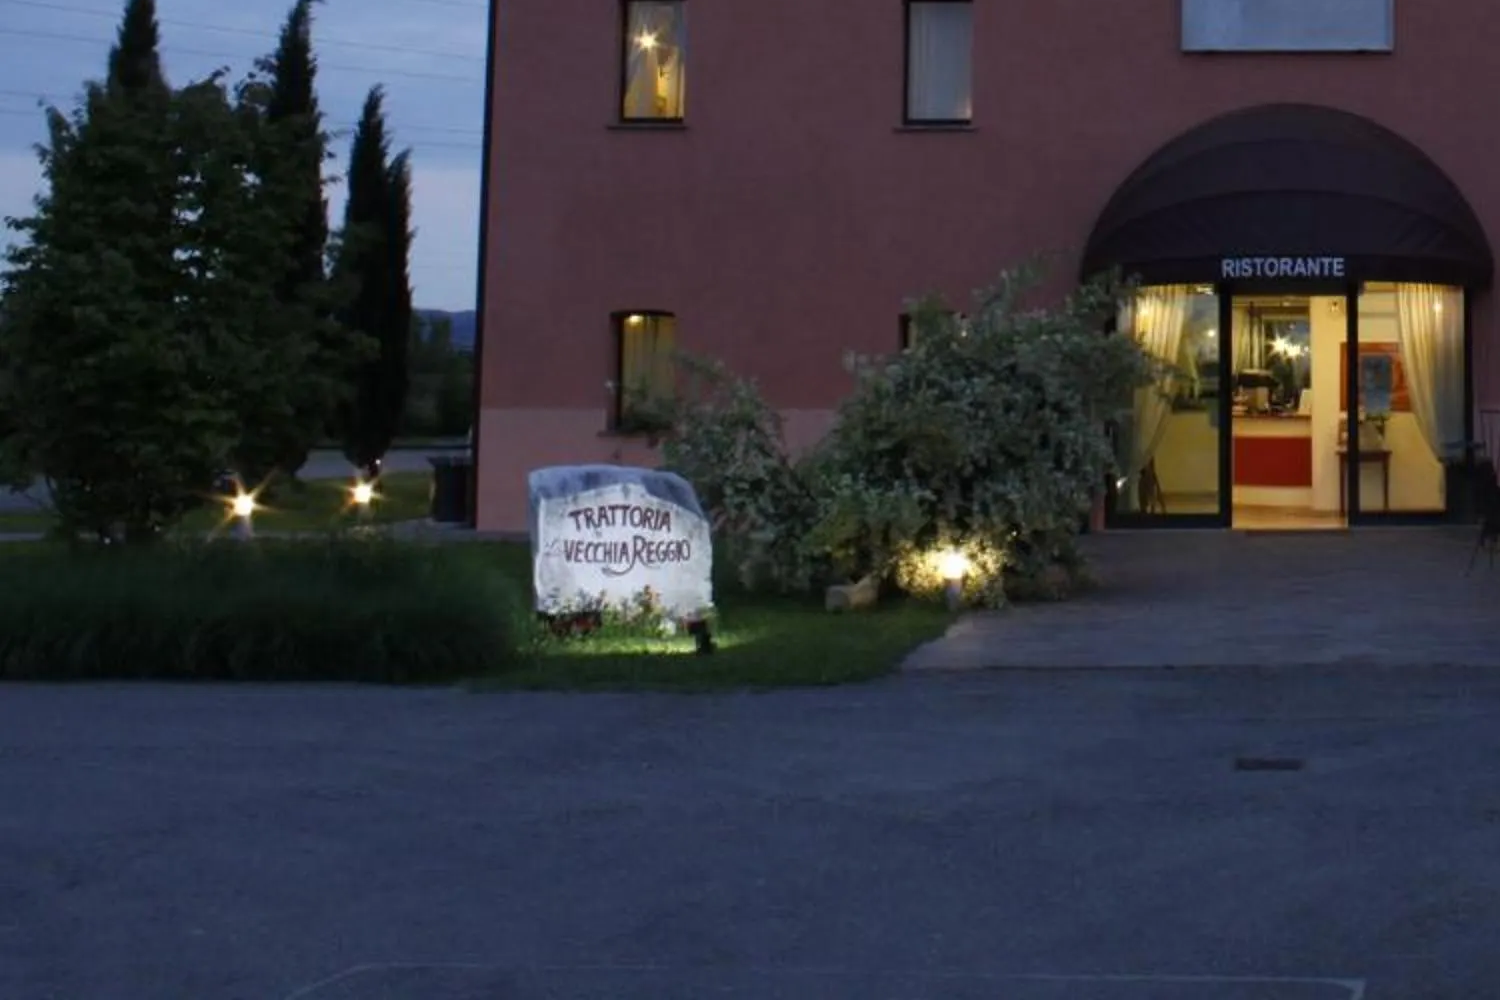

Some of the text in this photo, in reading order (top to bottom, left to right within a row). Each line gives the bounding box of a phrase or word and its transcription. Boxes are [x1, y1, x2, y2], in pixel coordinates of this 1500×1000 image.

[1221, 257, 1345, 278] RISTORANTE
[567, 504, 672, 533] TRATTORIA
[563, 539, 631, 565] VECCHIA
